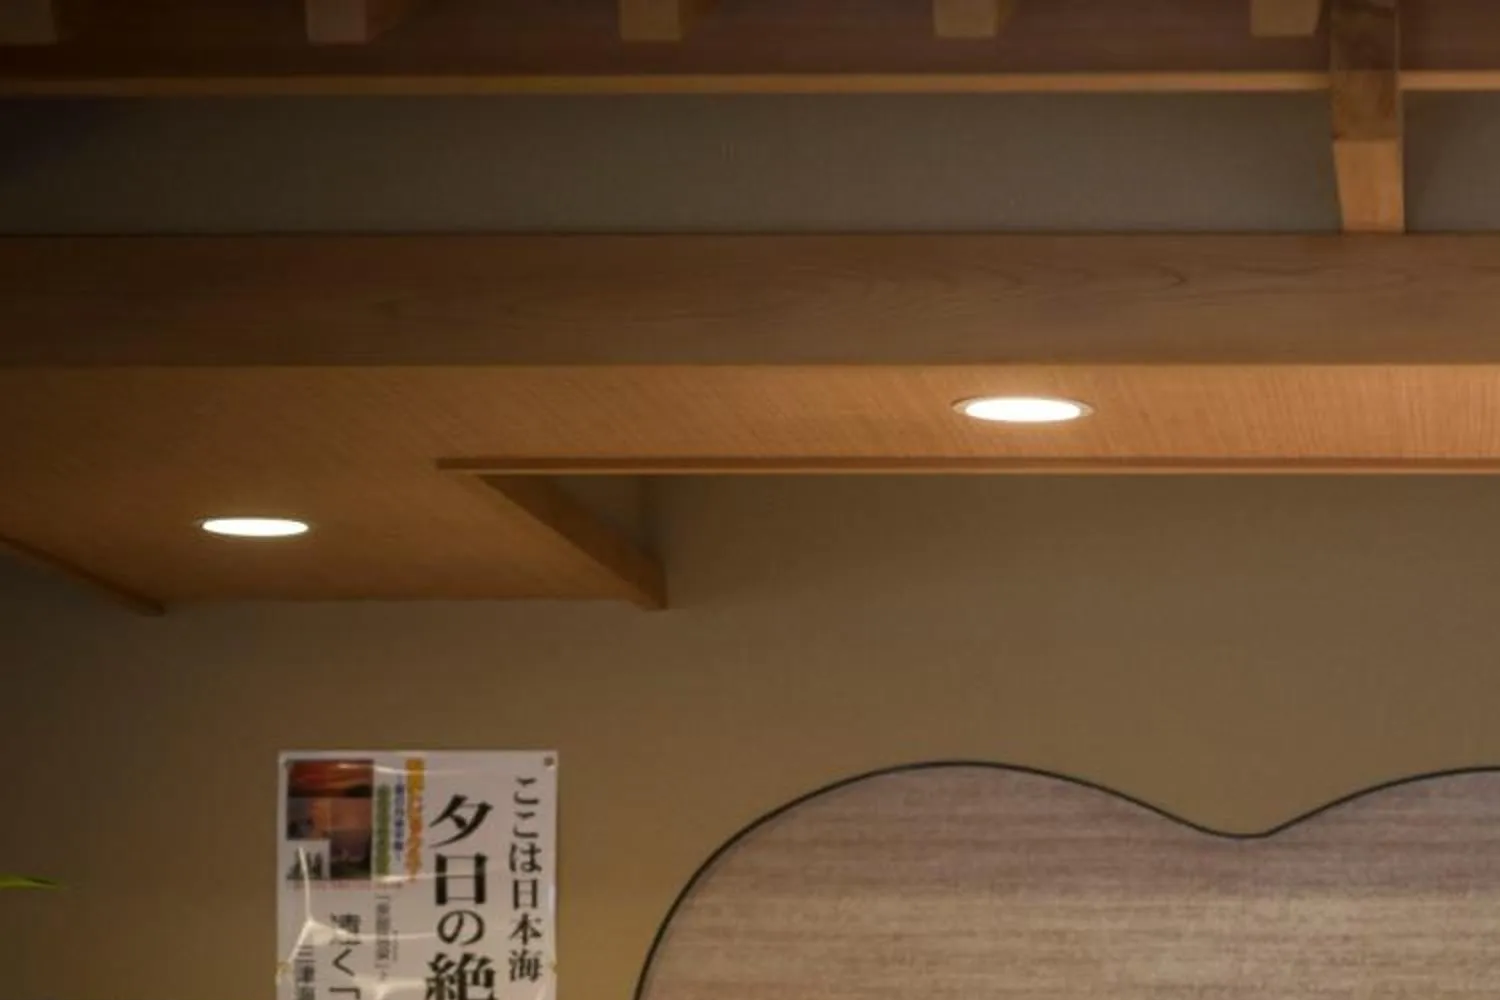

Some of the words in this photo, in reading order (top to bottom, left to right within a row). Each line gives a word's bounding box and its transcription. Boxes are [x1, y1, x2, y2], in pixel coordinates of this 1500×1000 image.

[507, 775, 543, 983] ここは日本海
